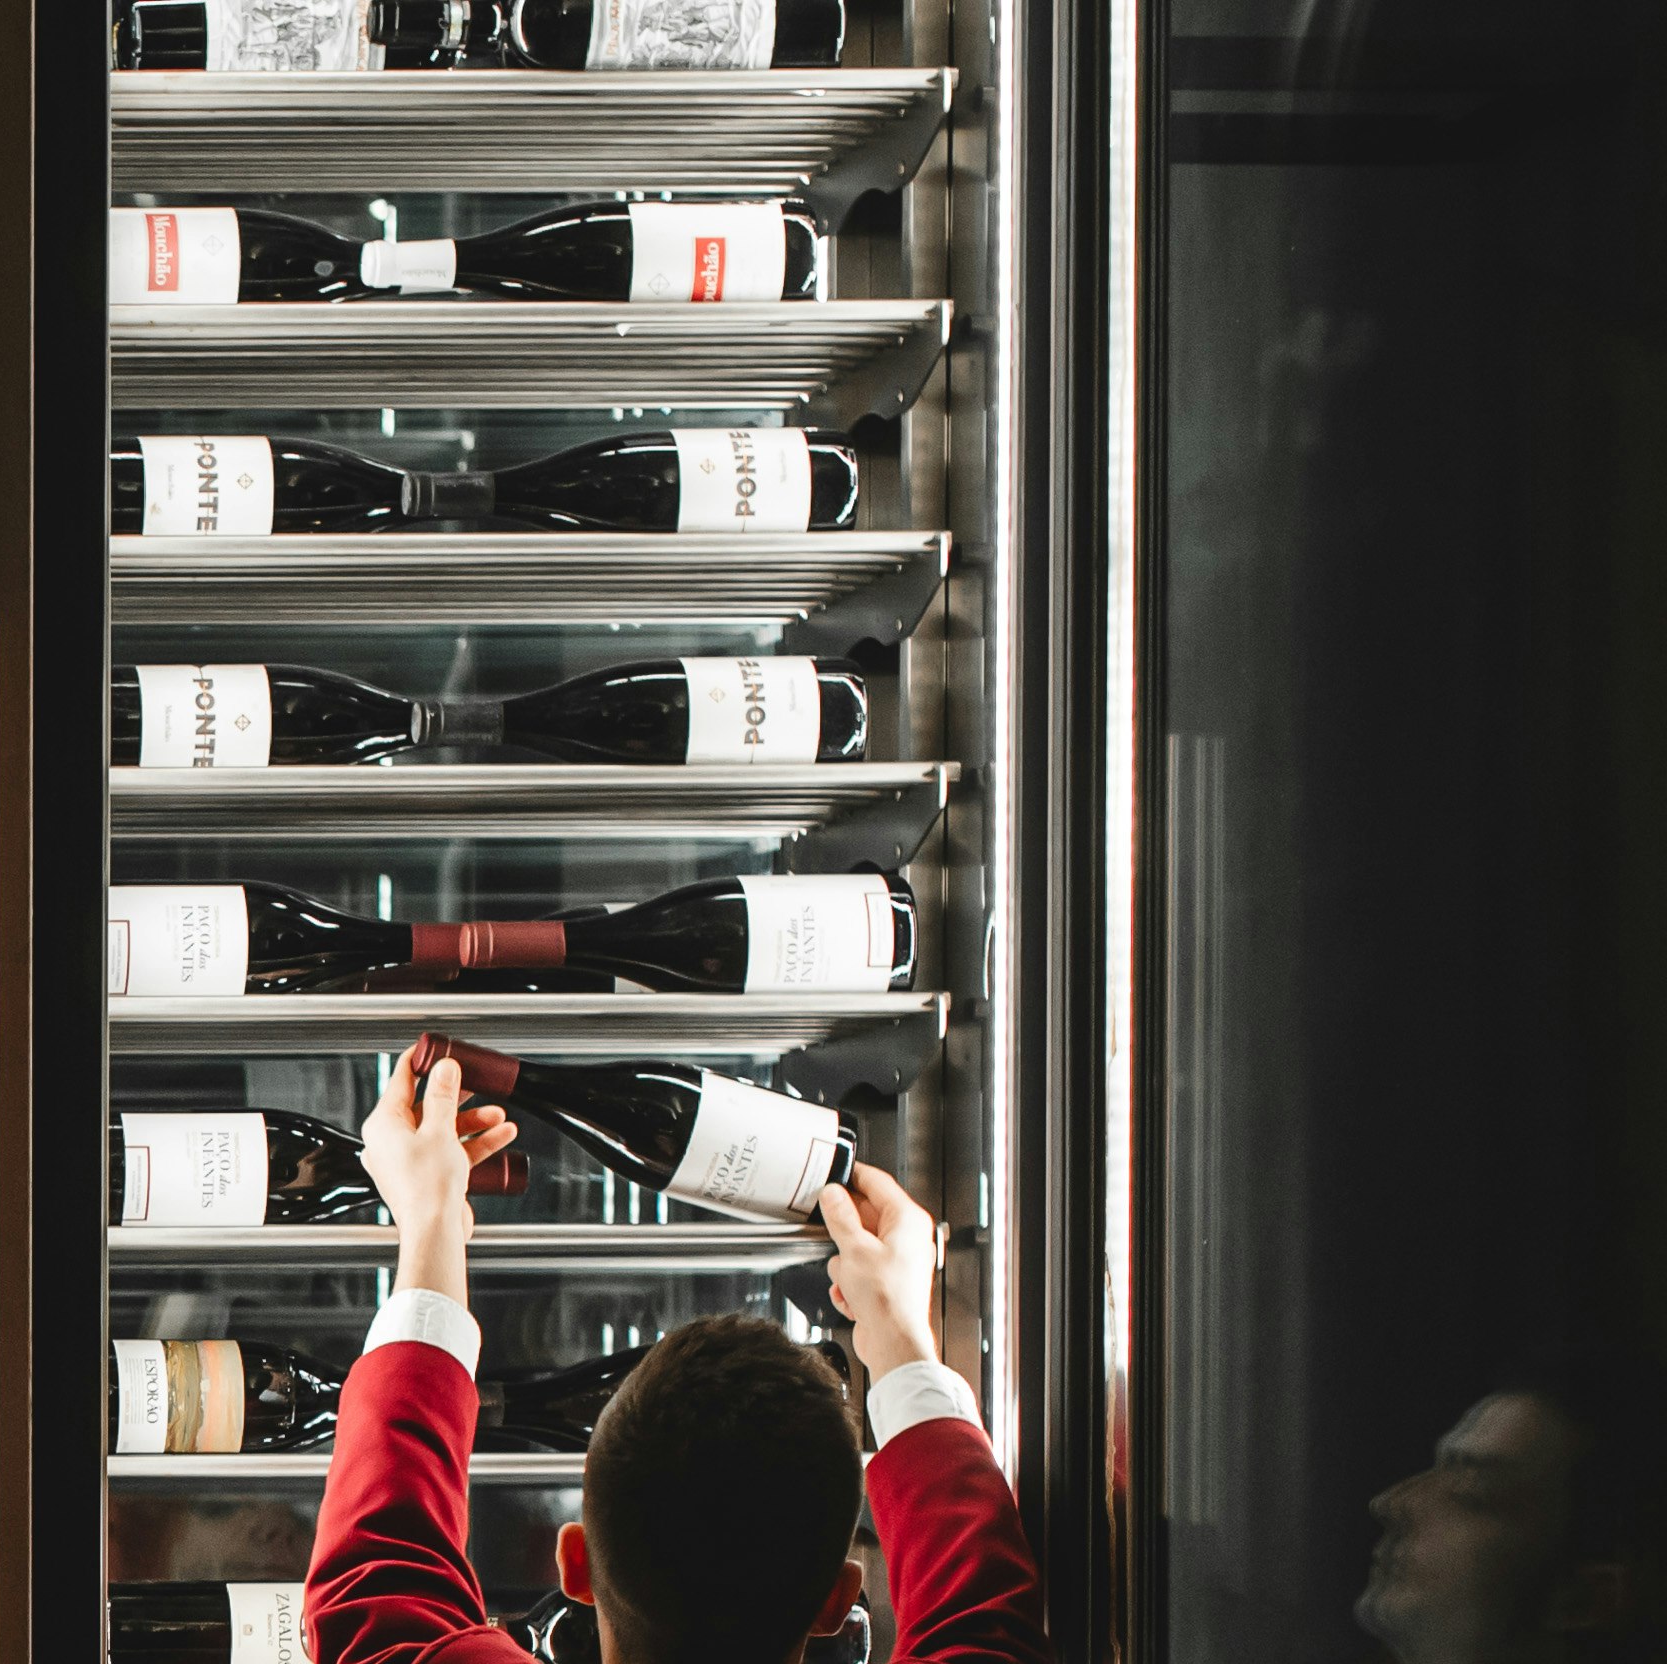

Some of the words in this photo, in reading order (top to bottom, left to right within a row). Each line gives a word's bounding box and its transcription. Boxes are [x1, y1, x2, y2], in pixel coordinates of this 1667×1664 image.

[153, 214, 174, 286] Mouchão
[193, 441, 218, 532] PONTE
[728, 431, 756, 517] PONTE
[192, 677, 217, 768] PONTE
[736, 659, 767, 746] PONTE
[180, 904, 194, 983] INFANTES
[196, 904, 211, 945] PAÇO
[198, 948, 210, 970] dos
[200, 1131, 215, 1209] INFANTES
[216, 1131, 232, 1172] PAÇO
[218, 1174, 230, 1197] dos
[144, 1357, 163, 1425] ESPORÃO
